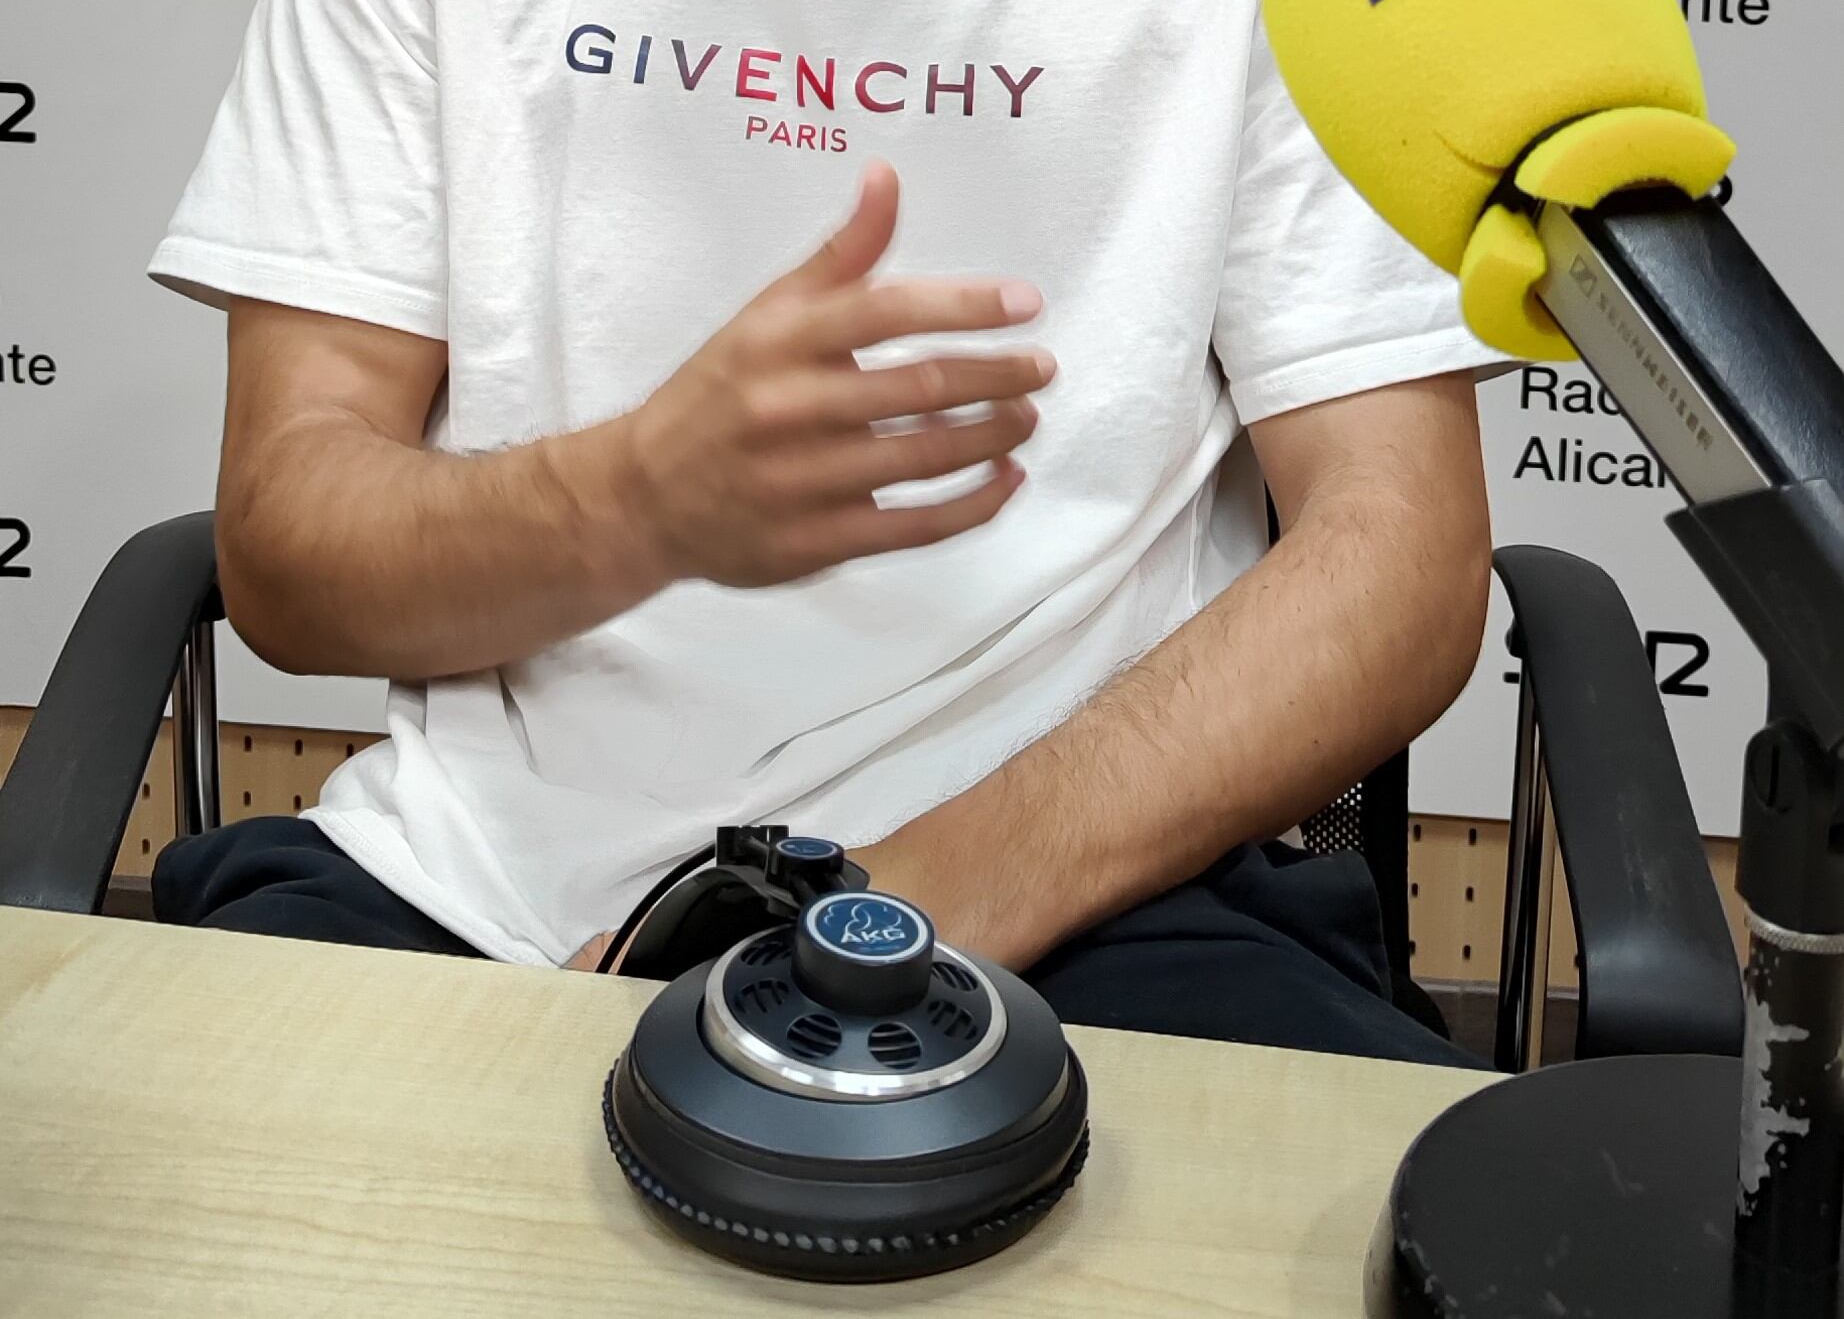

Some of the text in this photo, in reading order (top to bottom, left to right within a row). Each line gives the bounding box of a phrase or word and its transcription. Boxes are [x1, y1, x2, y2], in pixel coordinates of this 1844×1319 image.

[565, 23, 1045, 118] GIVENCHY
[745, 115, 848, 153] PARIS
[1512, 436, 1665, 488] Alica
[840, 928, 907, 944] AKG
